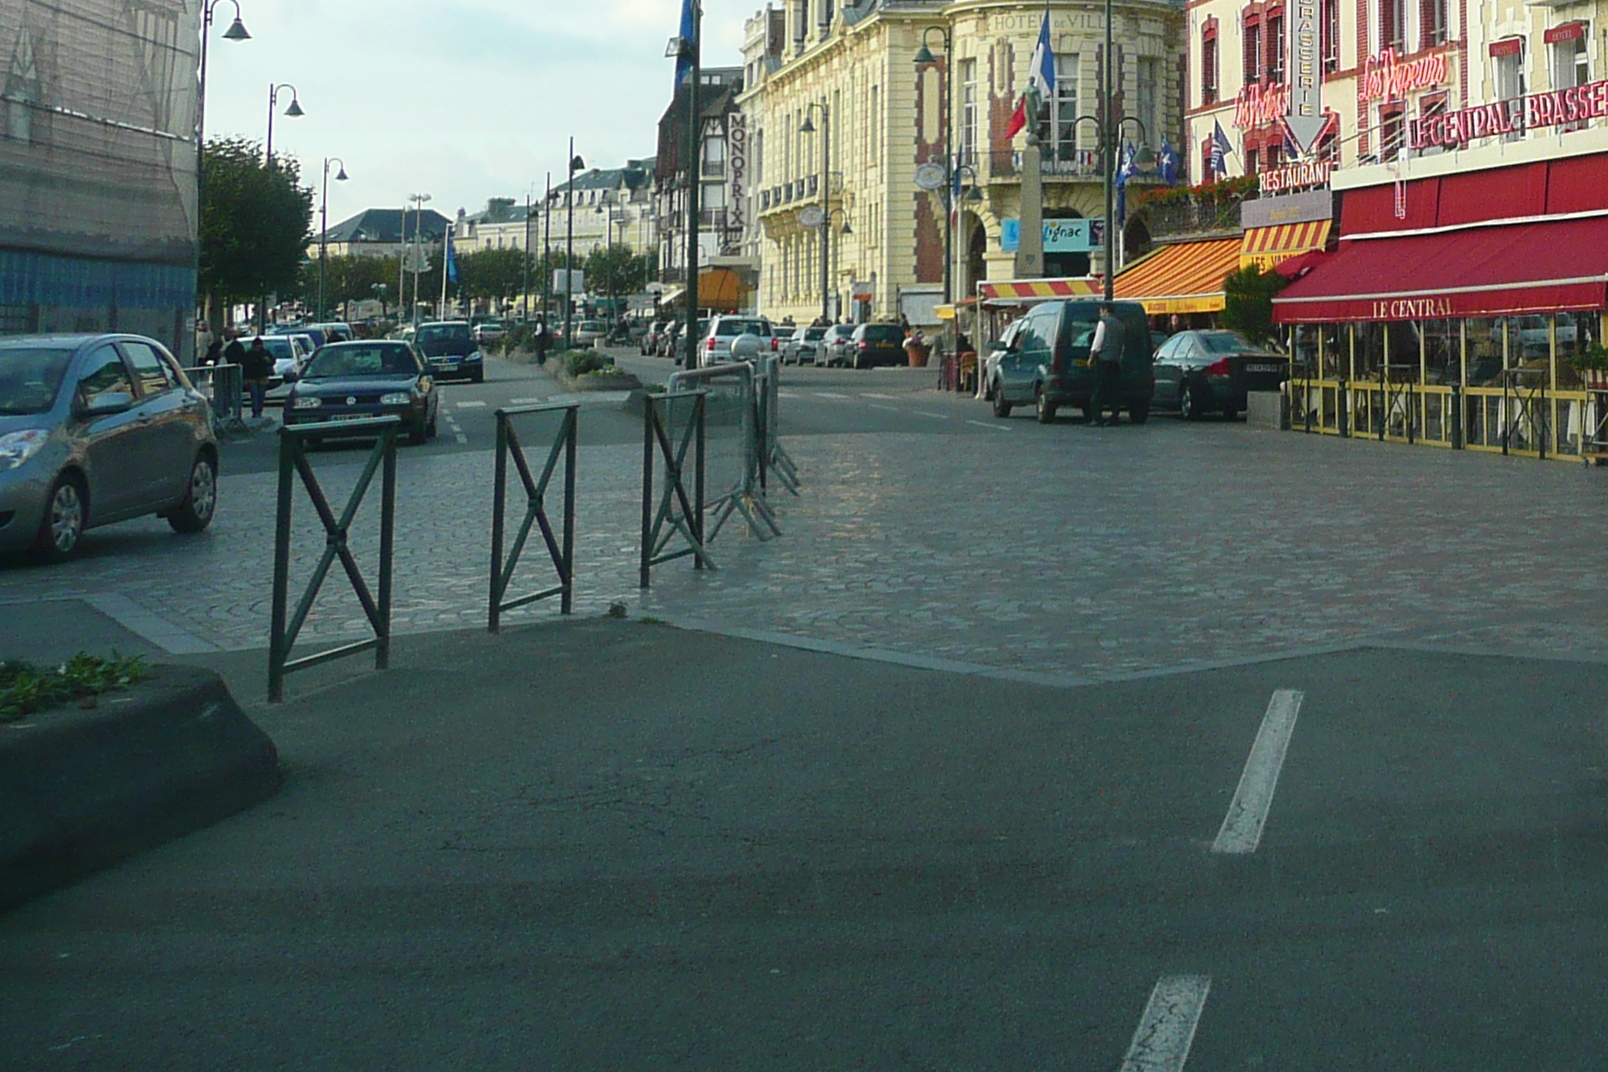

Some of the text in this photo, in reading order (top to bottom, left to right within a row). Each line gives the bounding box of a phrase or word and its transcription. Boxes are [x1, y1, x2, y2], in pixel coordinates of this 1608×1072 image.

[1551, 28, 1573, 41] HOTEL
[1359, 46, 1447, 105] Les Vapeurs
[1408, 116, 1430, 149] LE
[730, 114, 747, 226] MONOPRIX
[1258, 160, 1331, 193] RESTAURANT
[1372, 297, 1456, 319] LE CENTRAL
